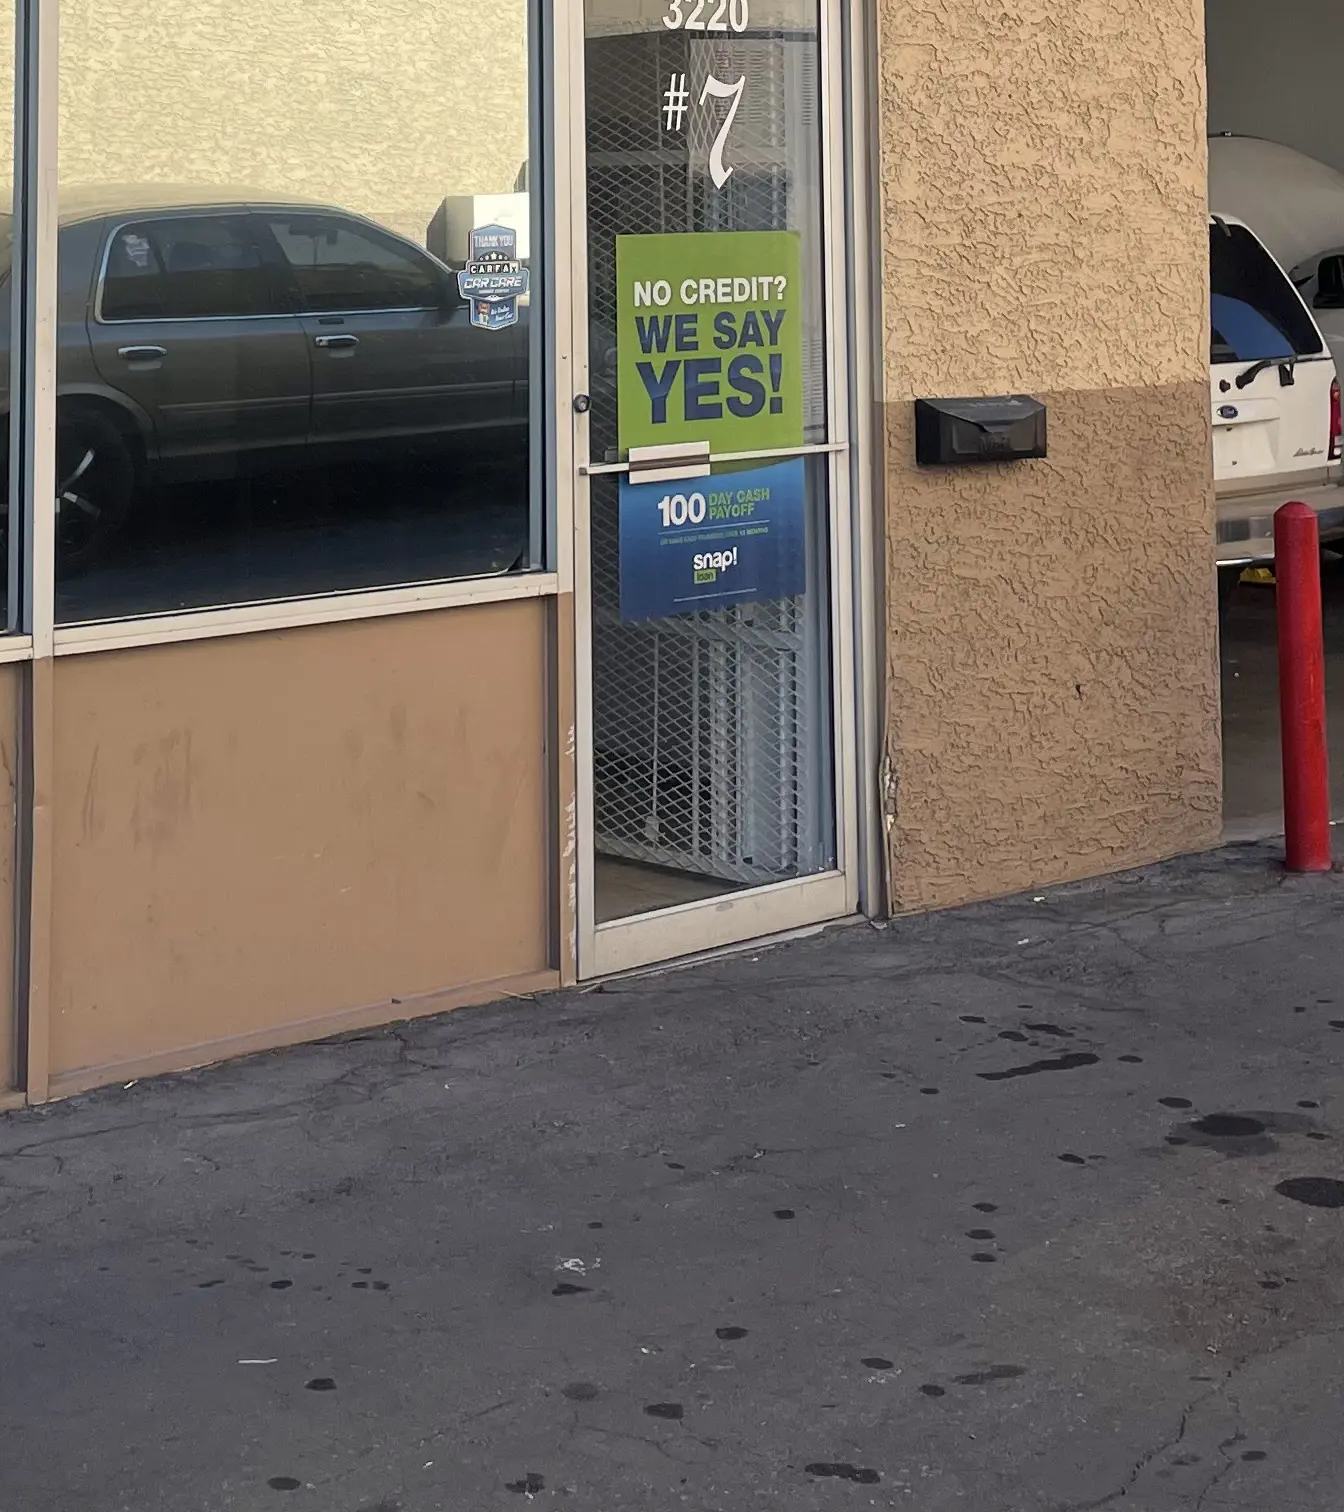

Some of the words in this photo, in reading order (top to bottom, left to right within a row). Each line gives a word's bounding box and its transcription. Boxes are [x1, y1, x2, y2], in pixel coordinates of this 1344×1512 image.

[473, 235, 498, 248] THANK
[499, 234, 514, 247] YOU
[470, 263, 518, 274] CARFAX
[464, 277, 489, 289] CAR
[490, 276, 523, 288] CARE
[633, 279, 672, 307] NO
[679, 275, 787, 306] CREDIT?
[634, 313, 699, 354] WE
[712, 309, 786, 350] SAY
[635, 352, 784, 425] YES!
[657, 492, 706, 527] 100
[709, 492, 733, 506] DAY
[737, 487, 770, 503] CASH
[709, 502, 755, 520] PAYOFF
[693, 546, 738, 572] snap!
